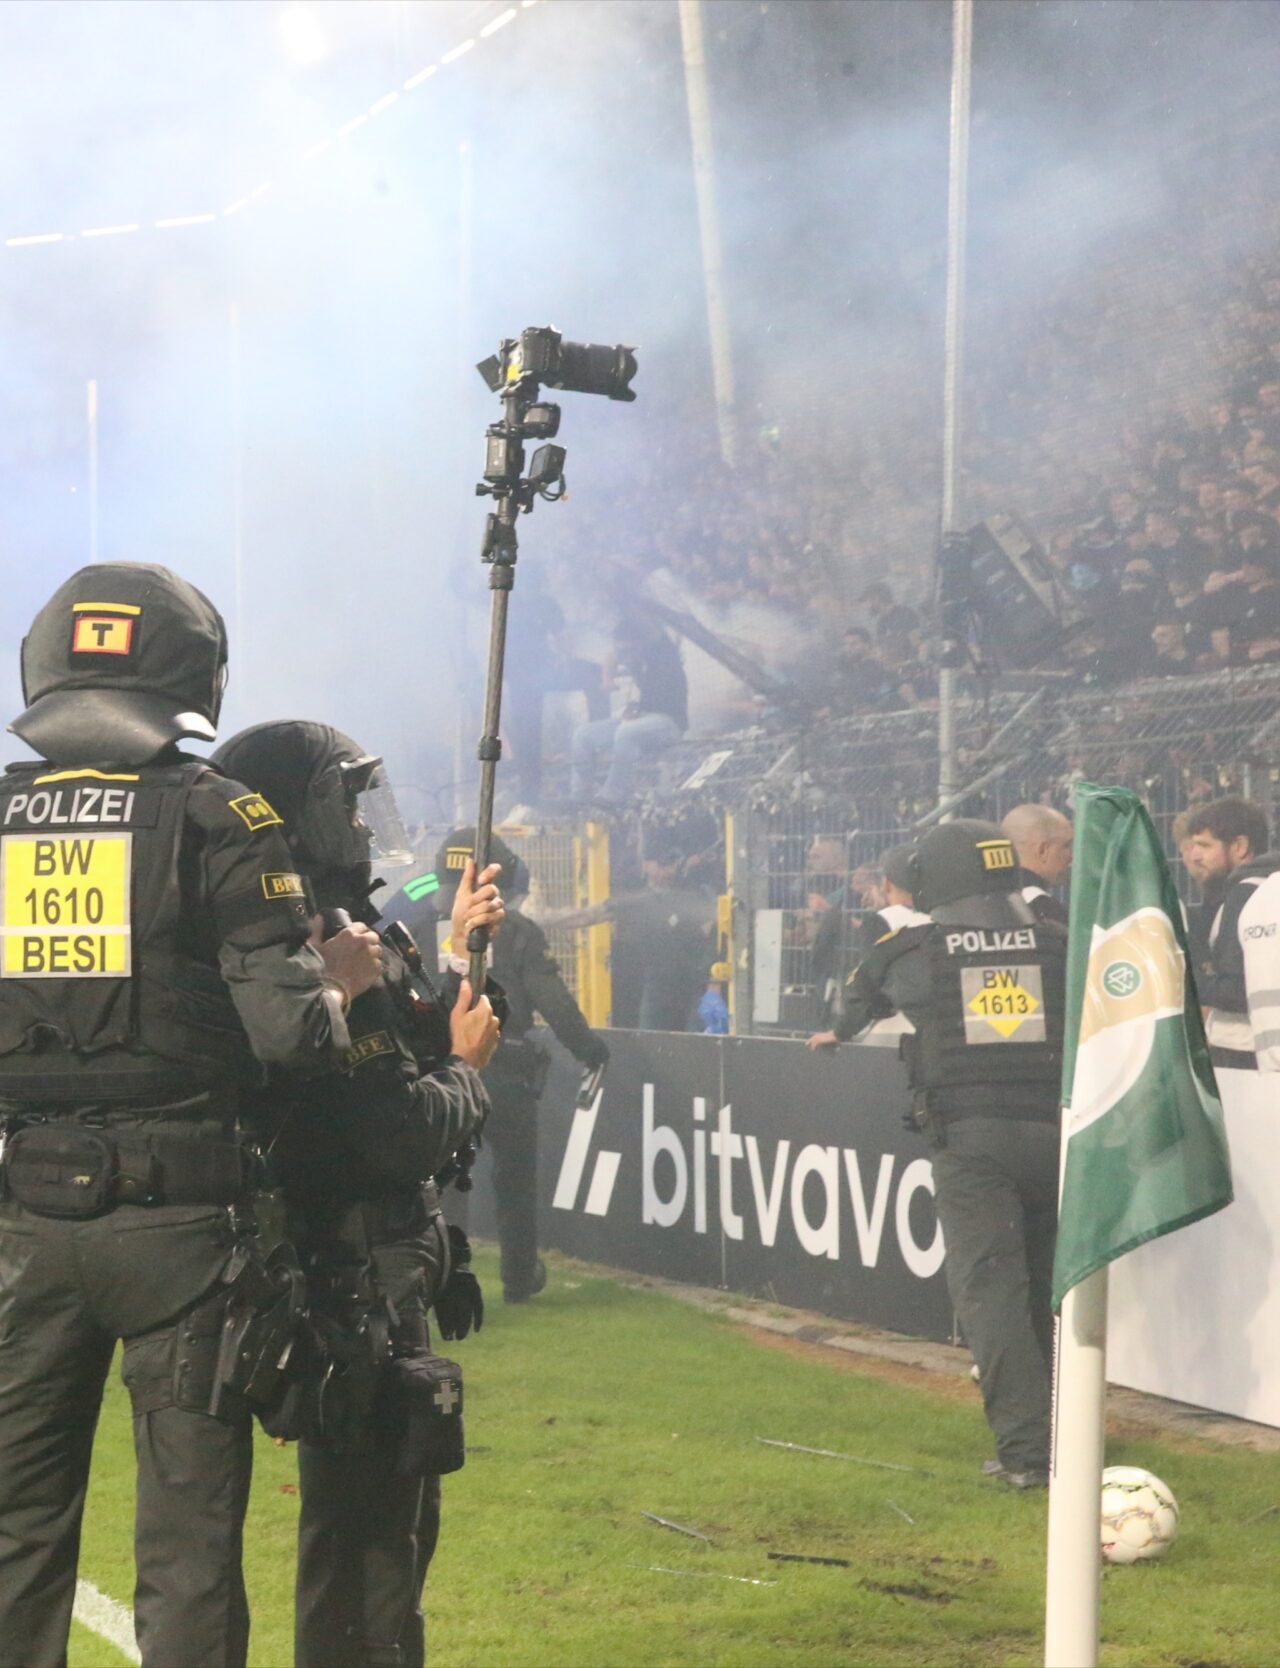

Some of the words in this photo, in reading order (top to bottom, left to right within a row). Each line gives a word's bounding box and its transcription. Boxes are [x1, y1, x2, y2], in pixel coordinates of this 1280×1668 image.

[92, 622, 114, 646] T
[4, 787, 135, 825] POLIZEI
[33, 839, 95, 876] BW
[25, 887, 104, 925] 1610
[22, 935, 106, 973] BESI
[945, 928, 1037, 954] POLIZEI
[982, 969, 1019, 989] BW
[979, 994, 1029, 1015] 1613
[642, 1083, 946, 1279] bitvavo
